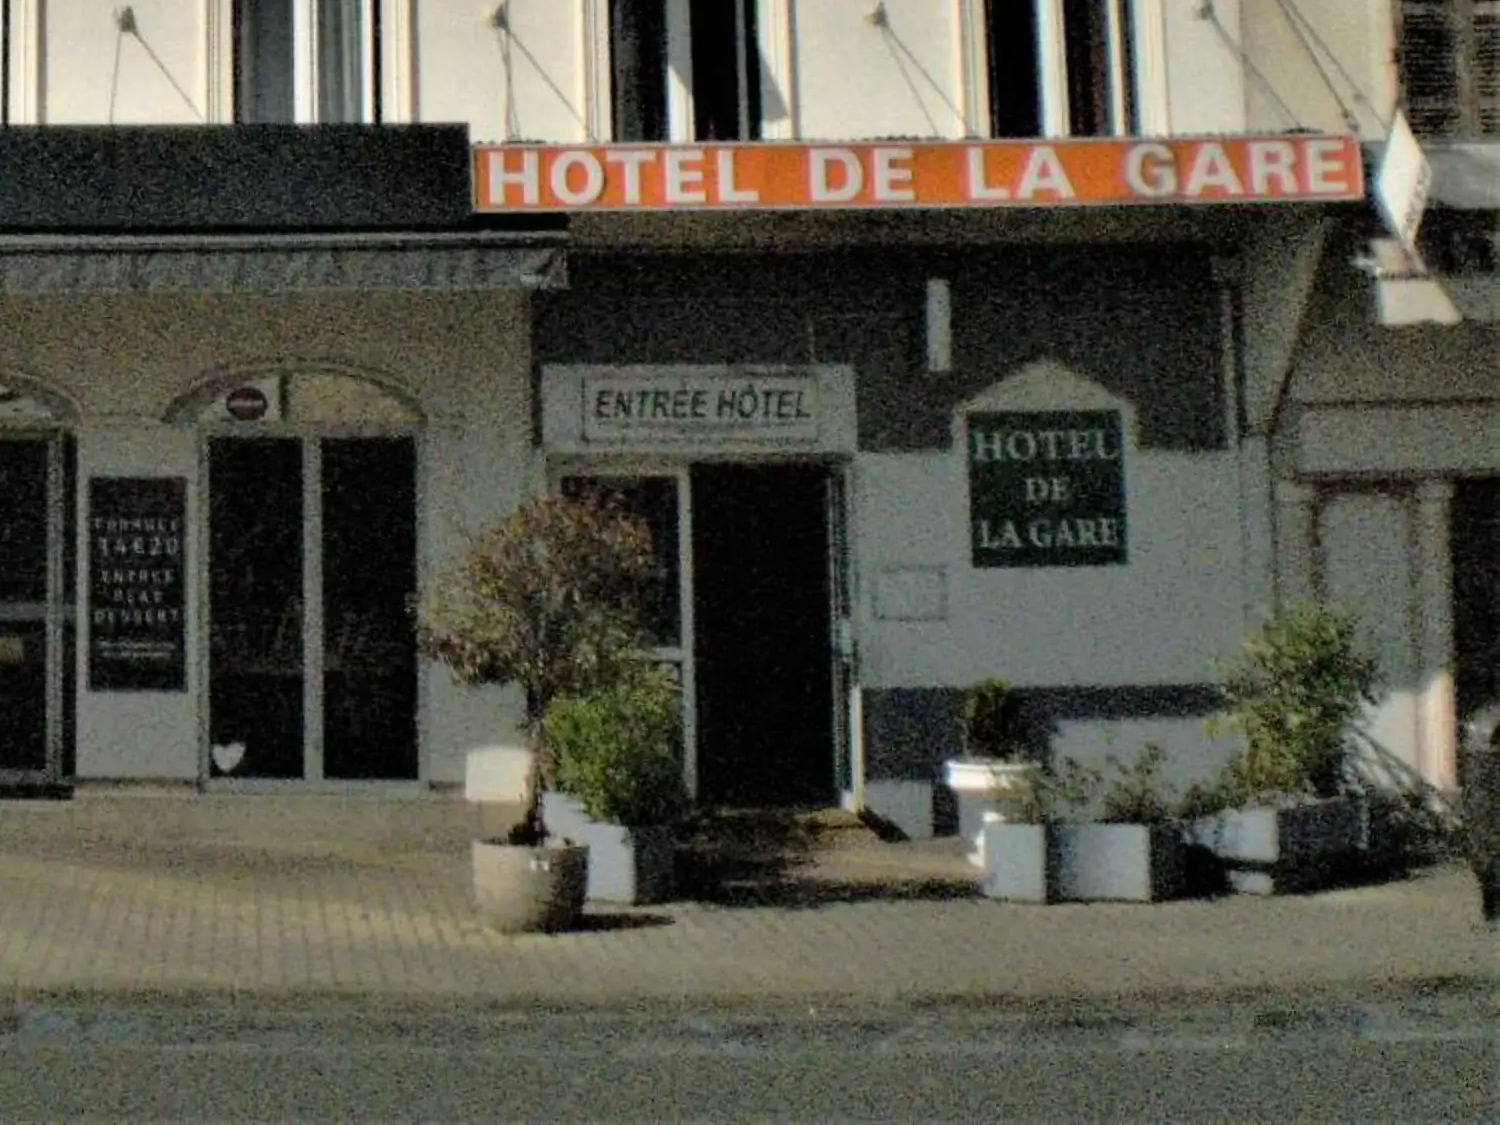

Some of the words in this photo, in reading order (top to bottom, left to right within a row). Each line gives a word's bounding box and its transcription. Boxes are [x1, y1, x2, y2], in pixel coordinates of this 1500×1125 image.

[487, 149, 759, 206] HOTEL
[809, 148, 914, 202] DE
[967, 145, 1075, 199] LA
[1124, 140, 1348, 197] GARE
[717, 383, 810, 418] HÔTEL
[974, 430, 1118, 460] HOTEL
[1025, 477, 1070, 502] DE
[979, 518, 1022, 548] LA
[1029, 518, 1118, 548] GARE
